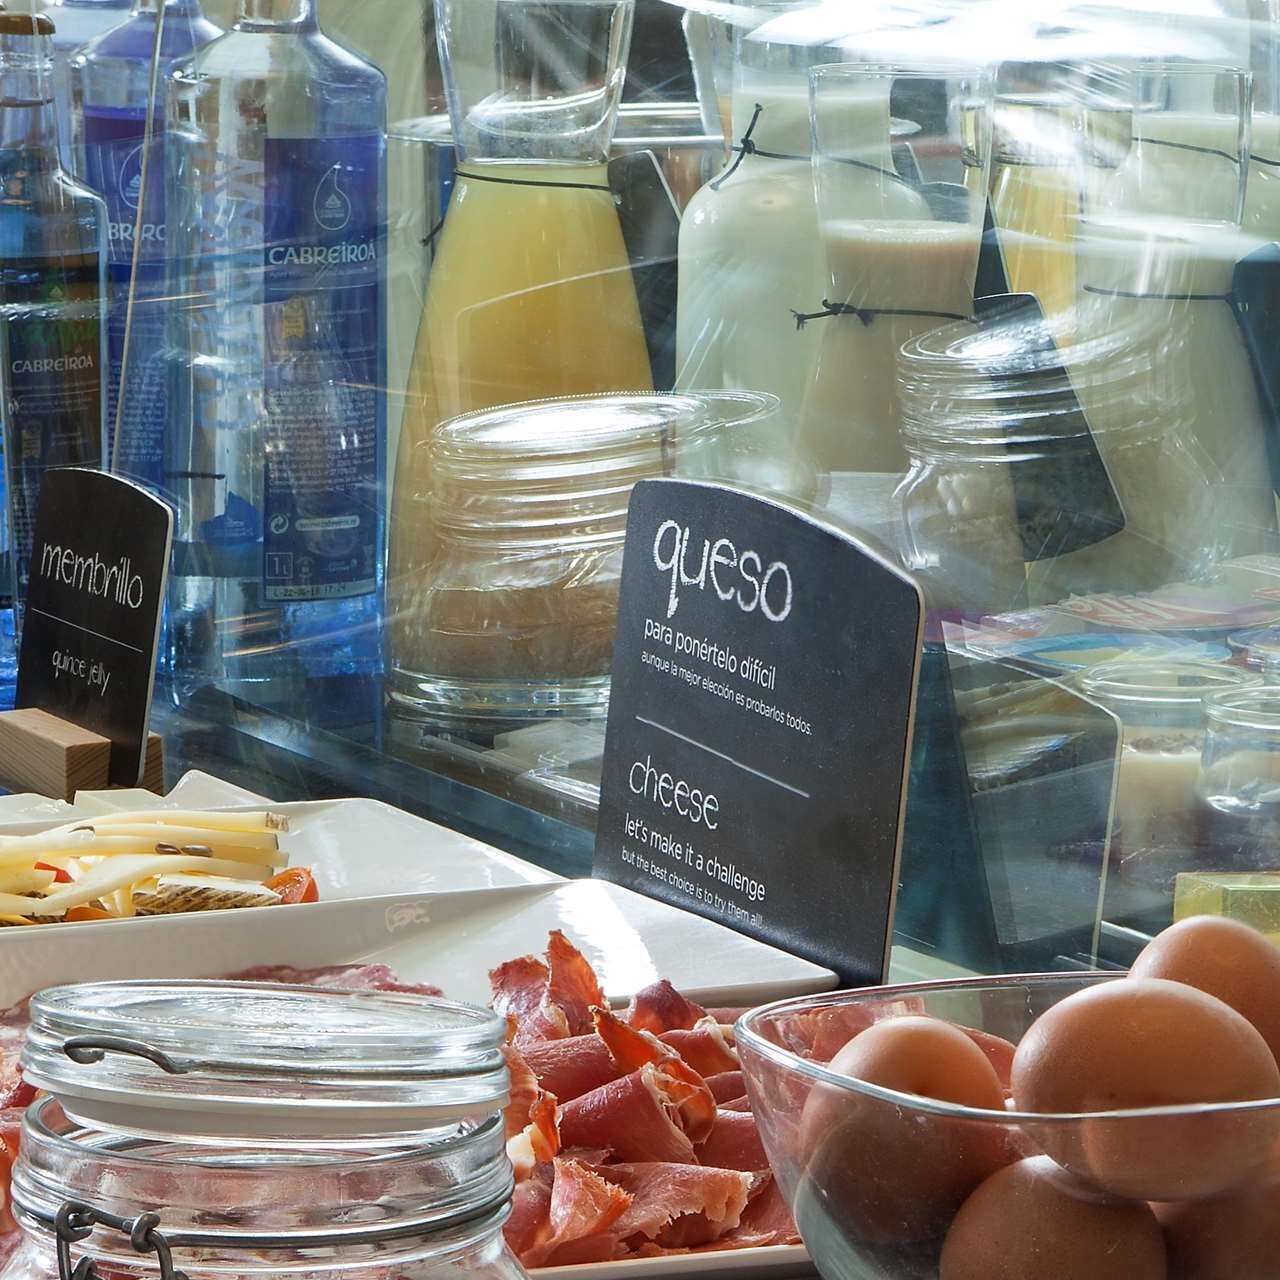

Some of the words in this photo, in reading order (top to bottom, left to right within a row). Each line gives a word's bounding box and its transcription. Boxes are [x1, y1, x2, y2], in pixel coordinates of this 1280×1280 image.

[40, 542, 144, 609] membrillo
[653, 519, 793, 622] queso
[52, 649, 86, 678] quince
[87, 659, 111, 696] jelly
[644, 618, 672, 645] para
[674, 631, 738, 673] ponértelo
[740, 656, 776, 690] difícil
[641, 650, 670, 673] aunque
[670, 660, 678, 676] la
[678, 666, 702, 686] mejor
[702, 677, 735, 701] elección
[735, 692, 745, 706] es
[746, 696, 785, 724] probarlos
[786, 711, 813, 735] todos.
[629, 755, 719, 830] cheese
[621, 846, 635, 866] but
[636, 855, 650, 872] the
[650, 860, 668, 882] best
[668, 872, 695, 895] choice
[695, 884, 703, 899] is
[704, 888, 713, 904] to
[714, 894, 727, 913] try
[727, 900, 750, 923] them
[624, 812, 648, 843] let's
[650, 834, 683, 860] make
[685, 843, 694, 867] it
[695, 854, 703, 871] a
[706, 856, 766, 901] challenge
